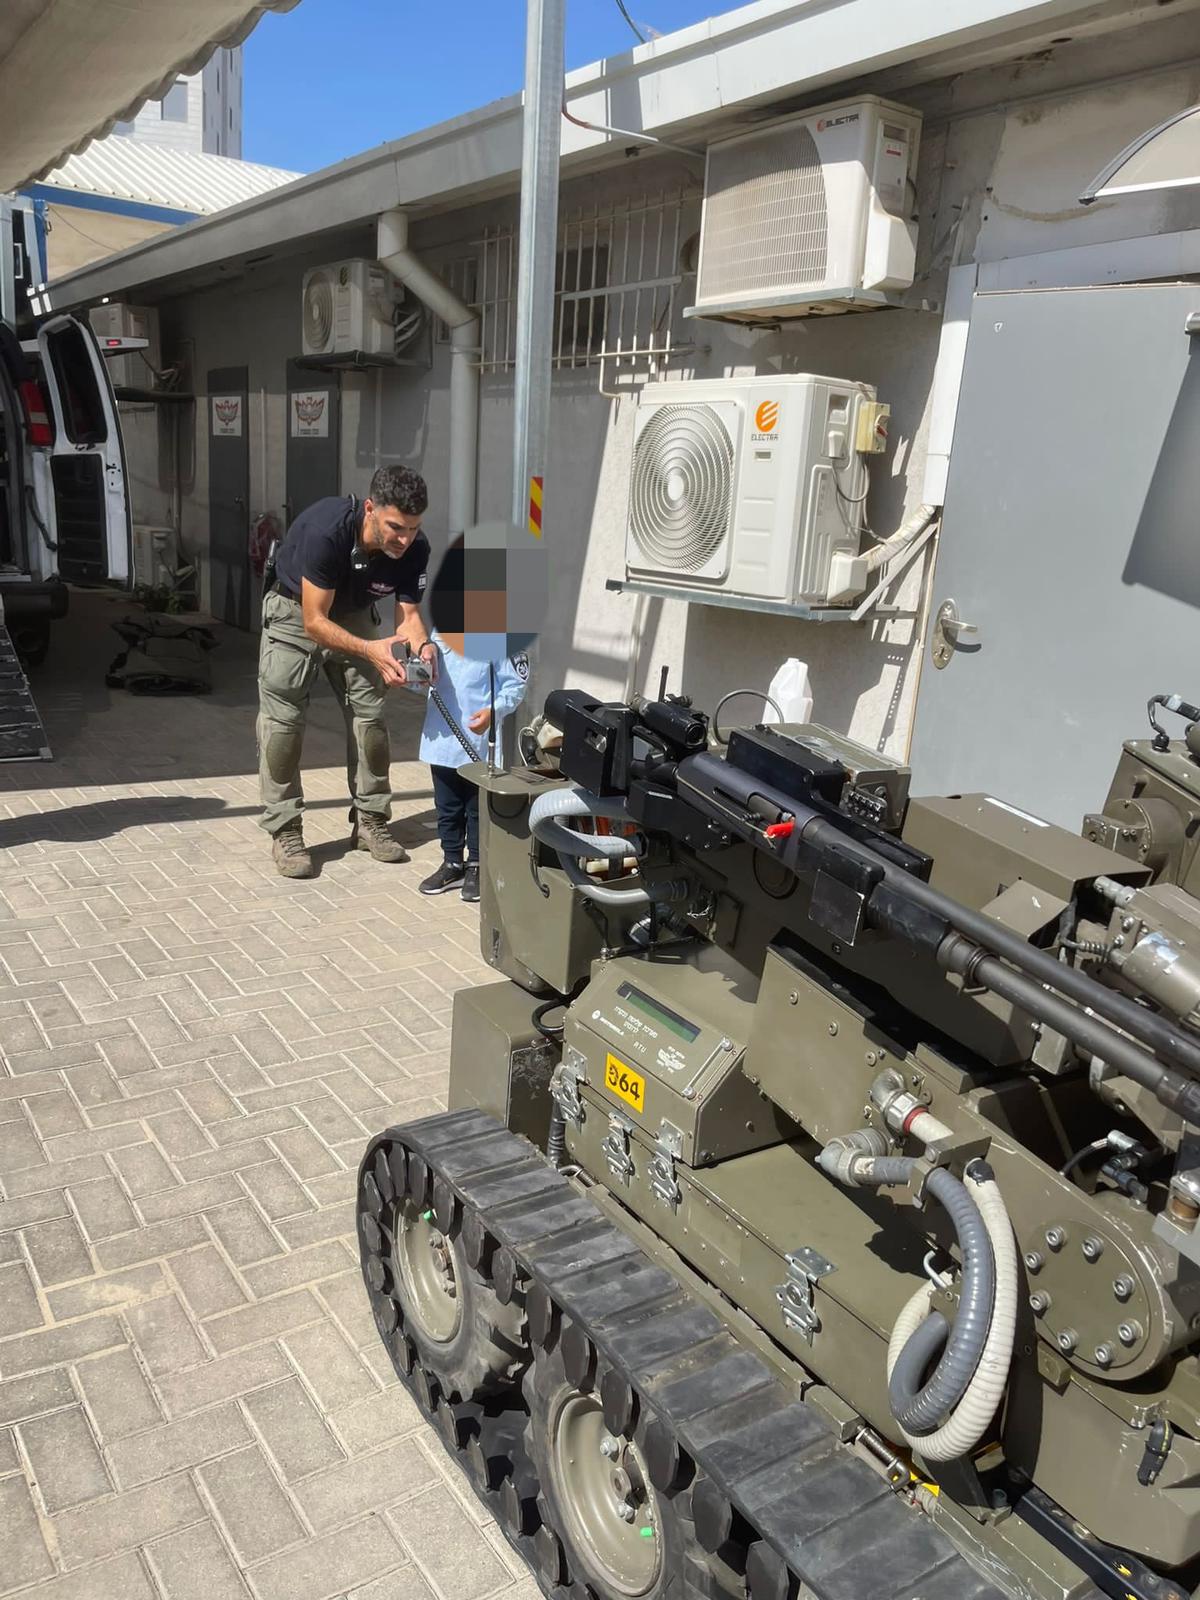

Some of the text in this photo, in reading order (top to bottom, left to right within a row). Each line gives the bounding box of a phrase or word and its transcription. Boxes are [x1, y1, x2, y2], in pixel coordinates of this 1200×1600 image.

[826, 113, 859, 128] ELECTRA
[751, 433, 779, 442] ELECTRA
[633, 1041, 648, 1053] RTU
